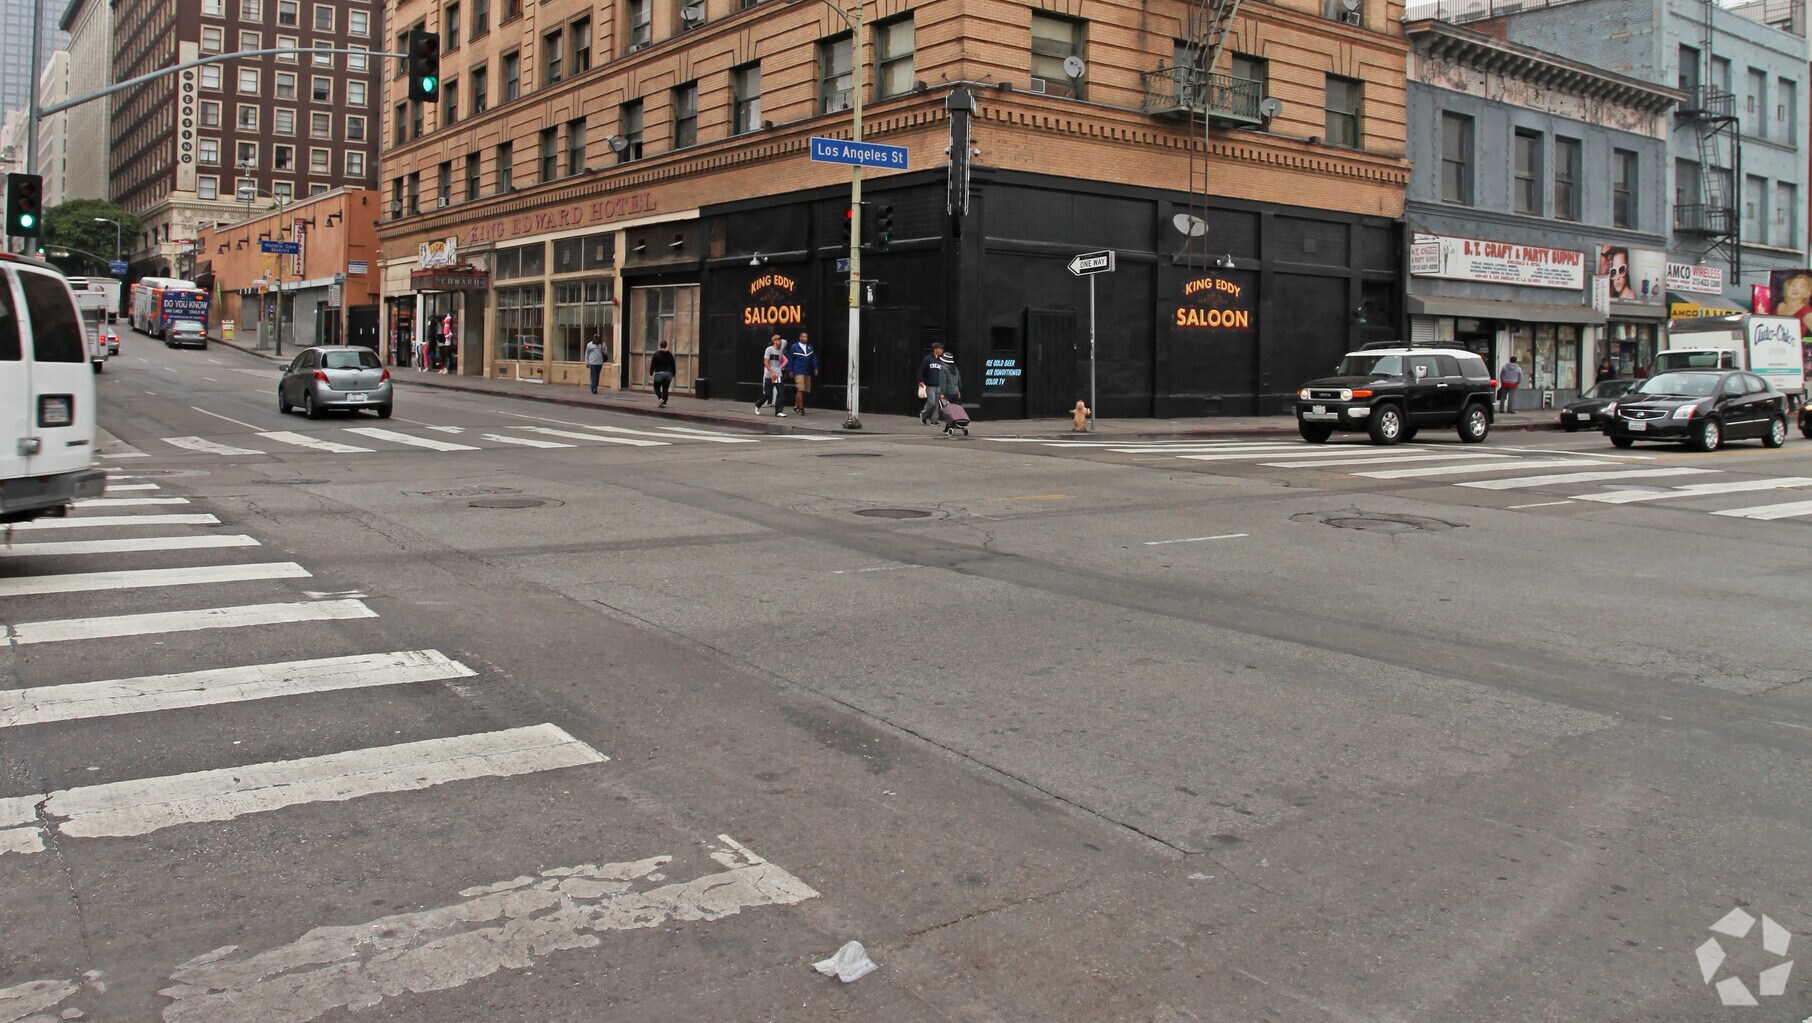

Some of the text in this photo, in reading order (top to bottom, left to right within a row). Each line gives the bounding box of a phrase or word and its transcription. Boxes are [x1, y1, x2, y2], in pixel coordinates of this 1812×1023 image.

[818, 143, 903, 164] Los Angeles St
[470, 193, 657, 242] KING EDWARD HOTEL
[1079, 257, 1106, 269] ONE WAY
[1485, 243, 1513, 259] CRAFT
[1515, 248, 1521, 257] &
[1523, 246, 1549, 264] PARTY
[1552, 250, 1580, 266] SUPPLY
[441, 276, 480, 286] EDWARD
[1667, 264, 1720, 279] AMCO WIRELESS
[751, 275, 794, 294] KING EDDY
[1185, 277, 1241, 297] KING EDDY
[164, 299, 208, 309] DO YOU KNOW
[744, 305, 801, 324] SALOON
[1176, 307, 1248, 327] SALOON
[985, 359, 1016, 367] ICE COLD BEER
[985, 378, 1006, 386] COLOR TV
